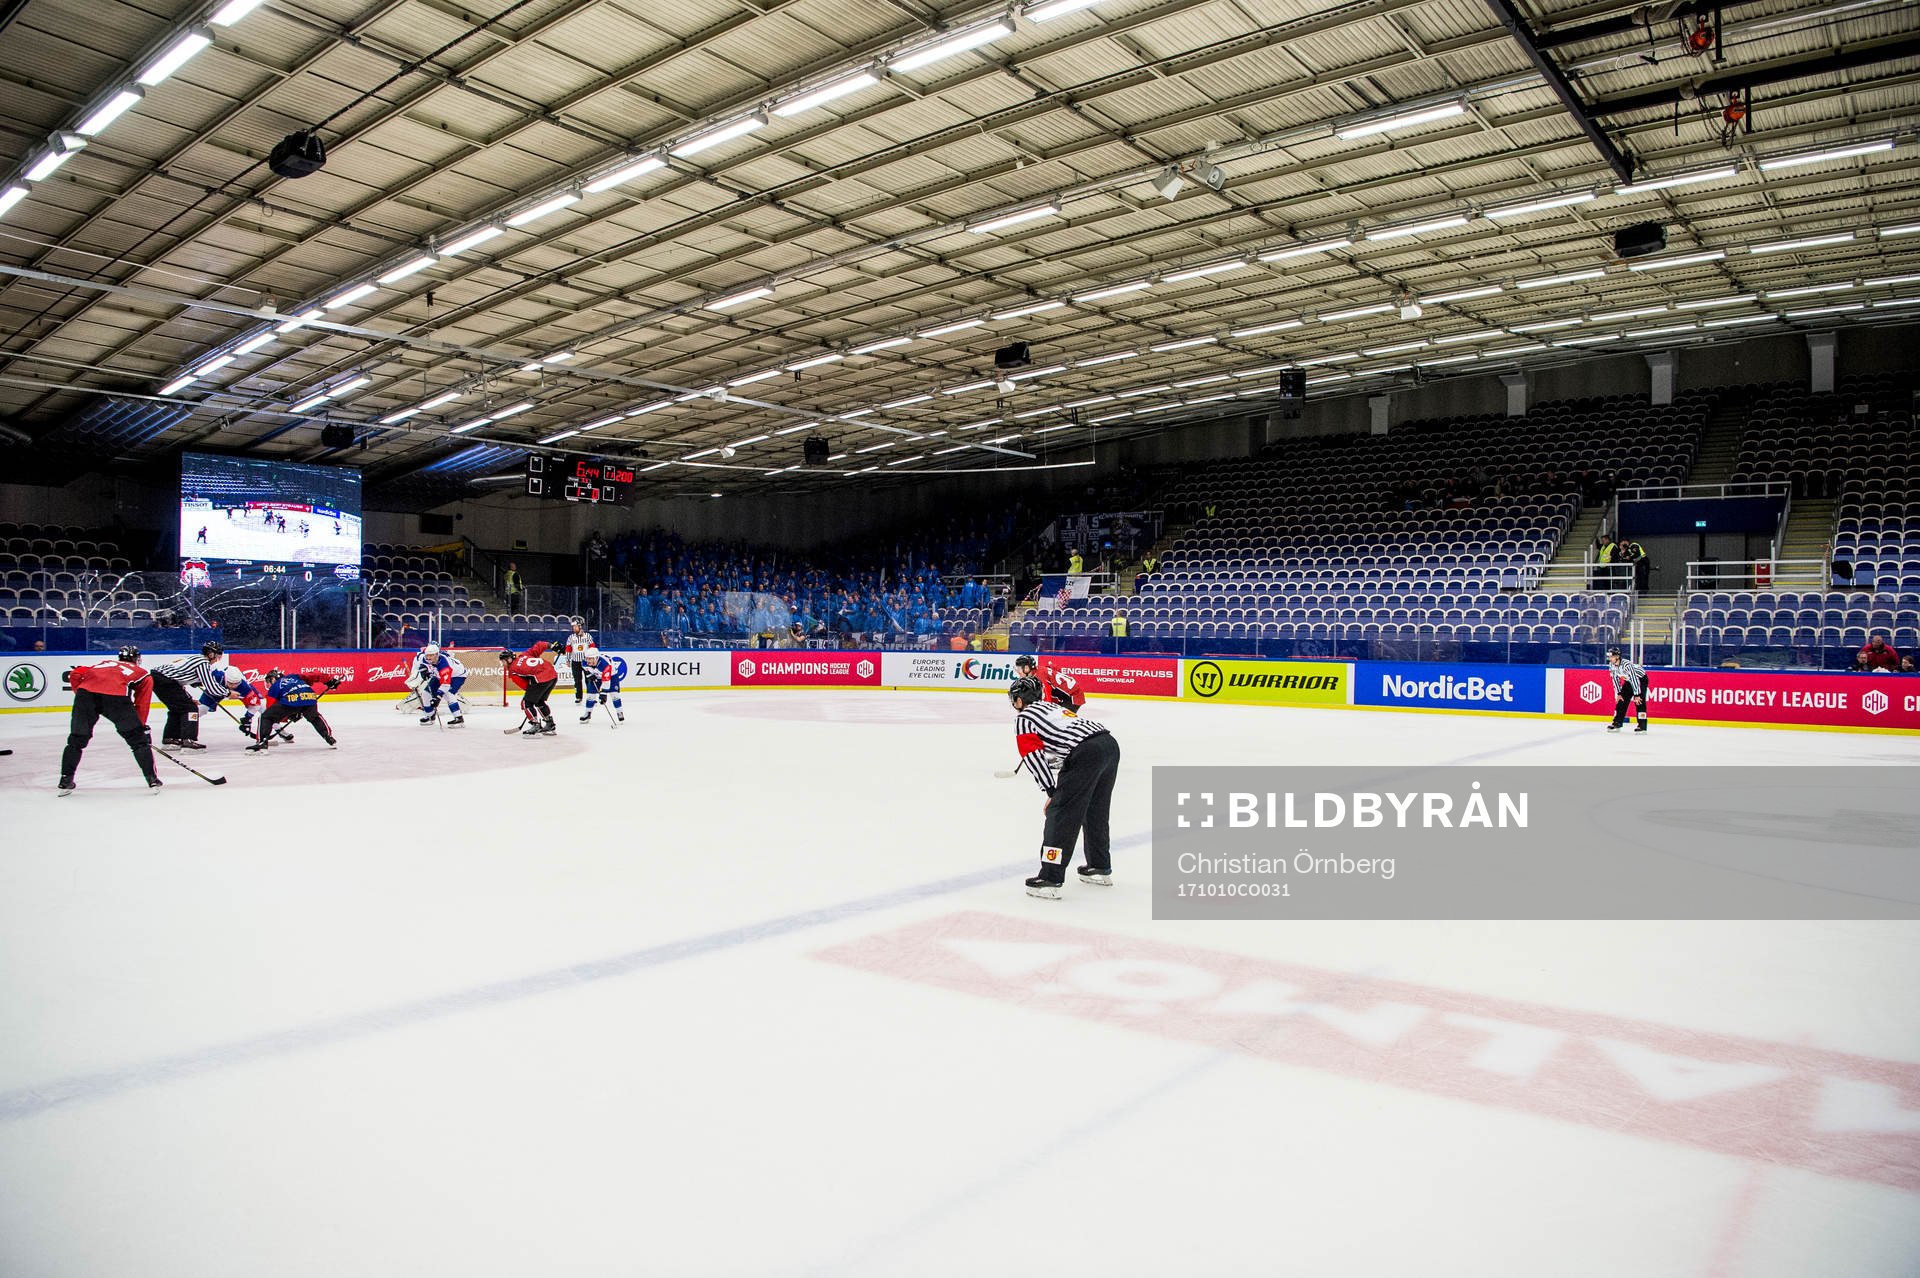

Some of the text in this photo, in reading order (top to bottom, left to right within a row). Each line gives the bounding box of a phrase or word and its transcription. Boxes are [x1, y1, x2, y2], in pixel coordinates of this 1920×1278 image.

[235, 565, 313, 582] 1 06:44 0
[635, 662, 701, 677] ZURICH
[739, 660, 755, 677] CHL
[761, 662, 829, 675] CHAMPIONS
[857, 661, 873, 678] CHL
[1061, 667, 1174, 678] ENGELBERT STRAUSS
[1228, 673, 1339, 690] WARRIOR
[1382, 674, 1514, 702] NordicBet
[1581, 682, 1602, 703] CHL
[1711, 689, 1777, 707] HOCKEY
[1782, 691, 1848, 709] LEAGUE
[1863, 690, 1887, 714] CHL
